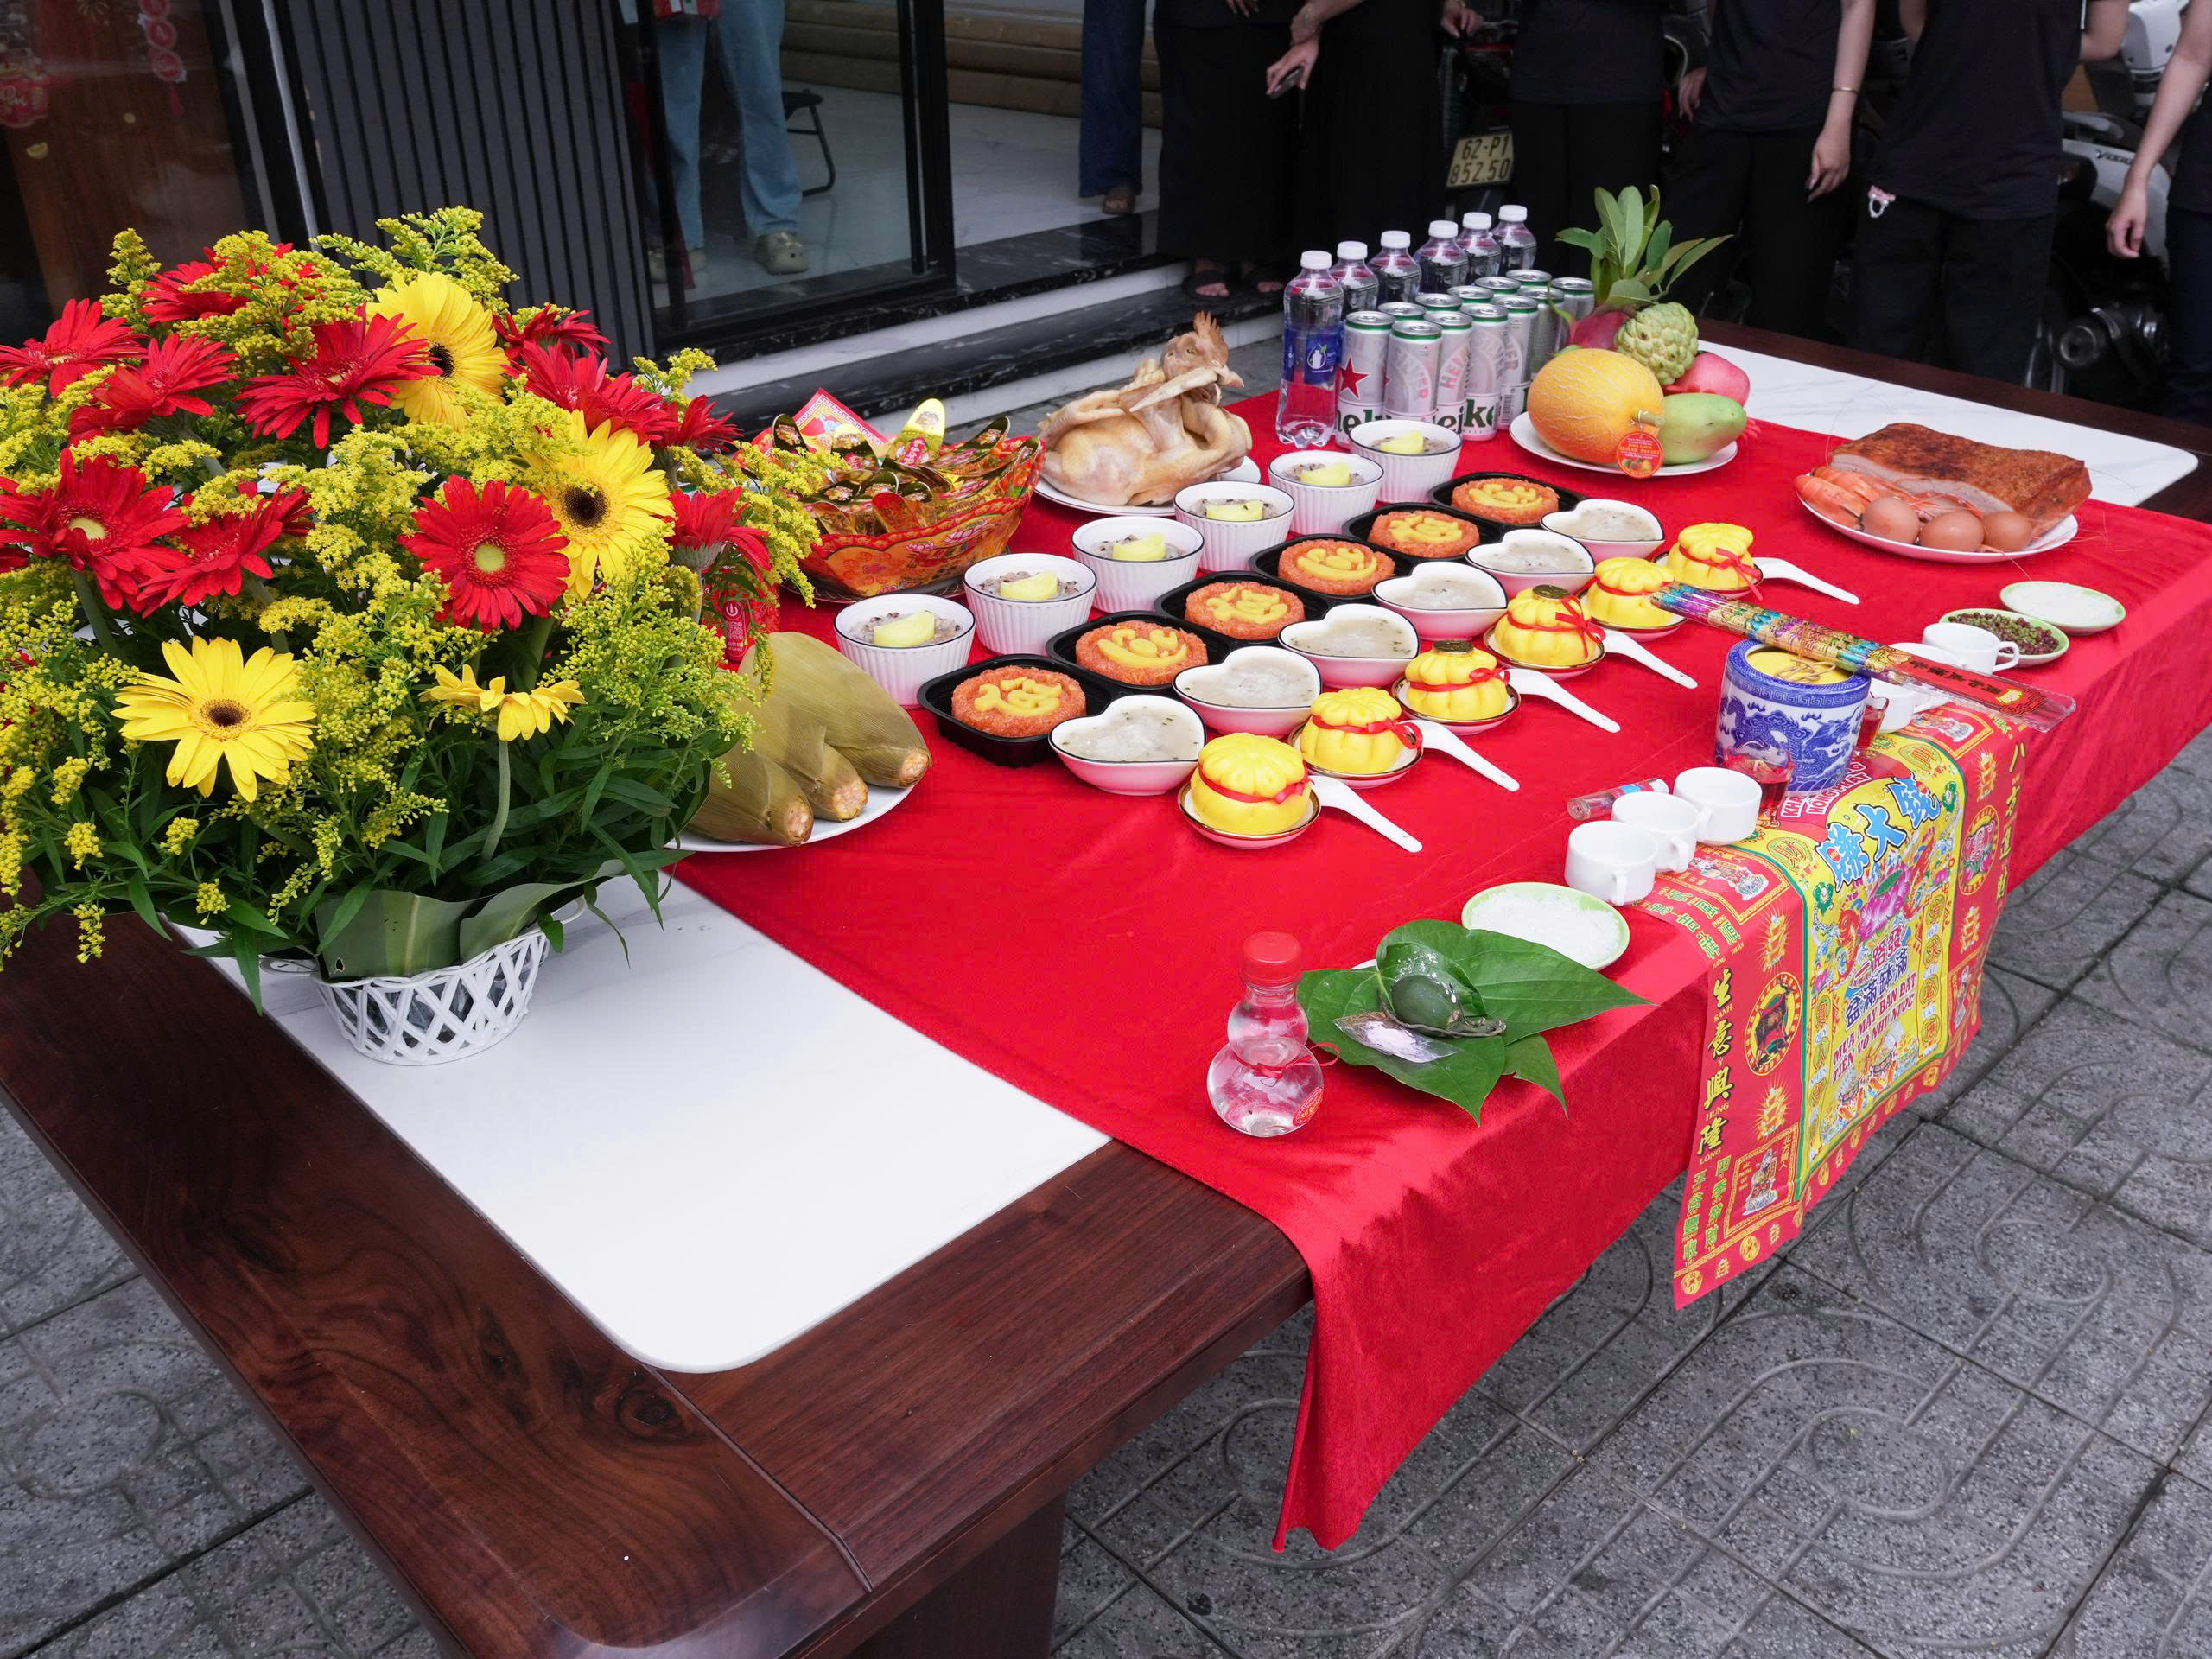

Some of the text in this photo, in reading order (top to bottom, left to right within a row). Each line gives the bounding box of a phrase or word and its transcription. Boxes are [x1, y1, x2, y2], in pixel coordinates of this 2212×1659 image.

[1461, 135, 1510, 160] 62-P1
[1449, 158, 1510, 184] 852.50
[1699, 1148, 1722, 1166] LONG
